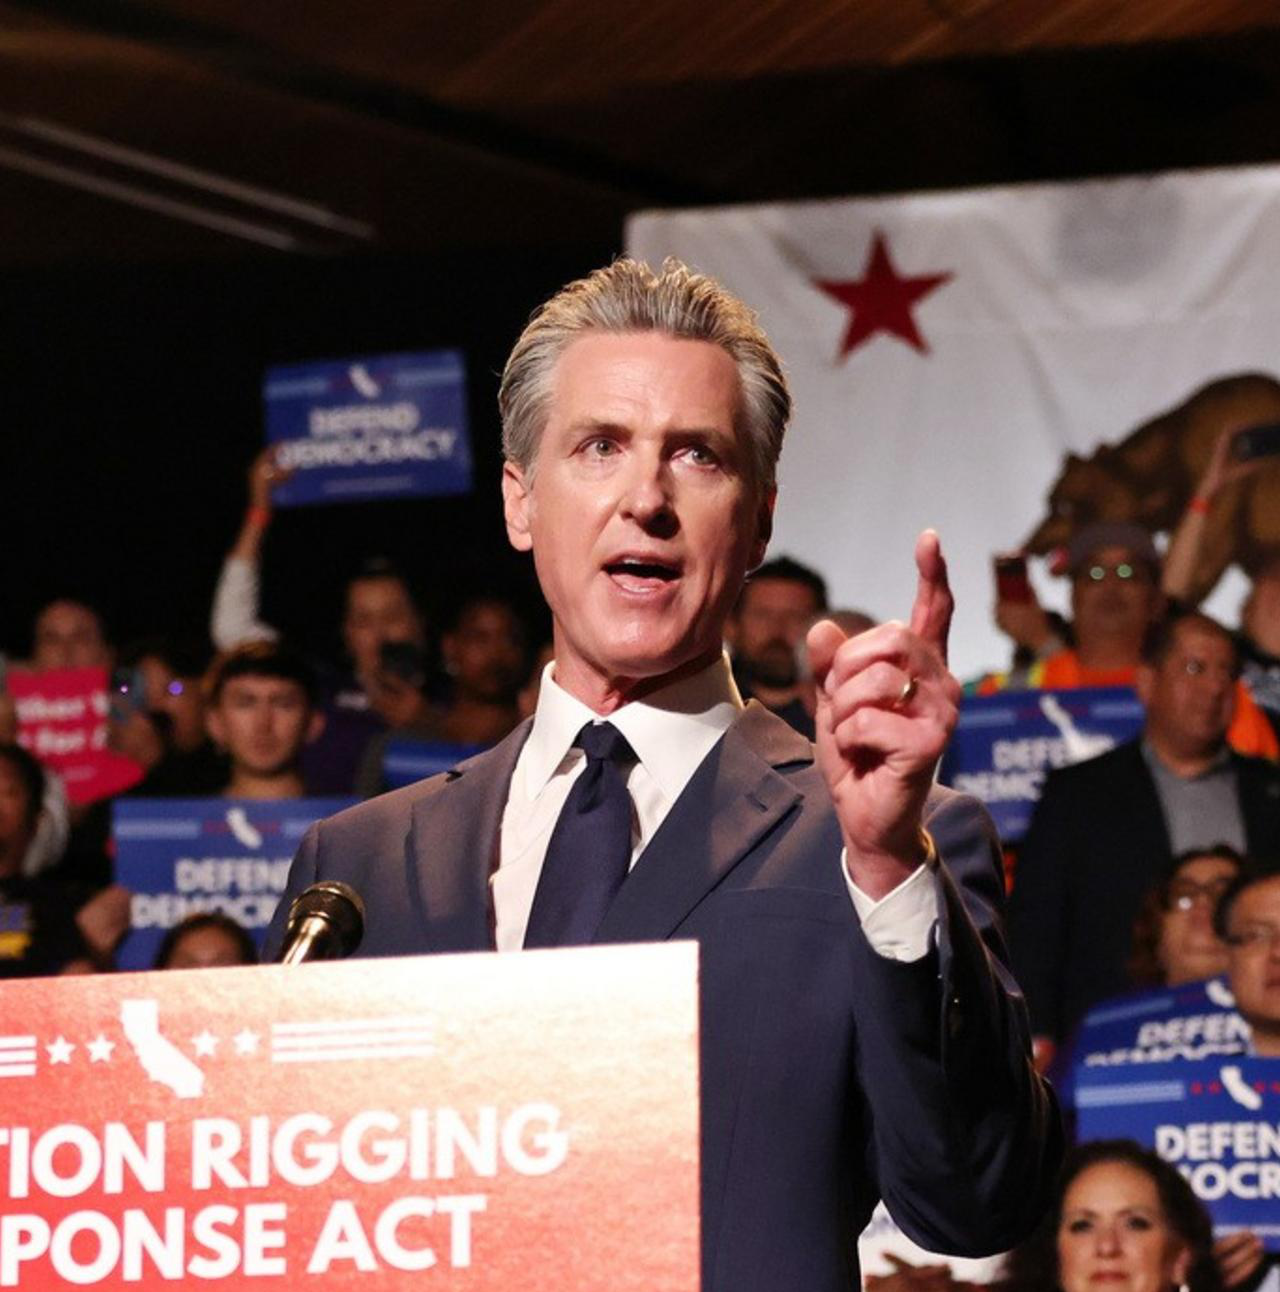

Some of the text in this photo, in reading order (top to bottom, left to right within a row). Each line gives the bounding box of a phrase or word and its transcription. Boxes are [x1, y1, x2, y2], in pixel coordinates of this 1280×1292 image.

[175, 858, 293, 893] DEFEN
[1136, 1013, 1253, 1049] DEFEN
[190, 1103, 569, 1191] RIGGING
[307, 1195, 488, 1275] ACT
